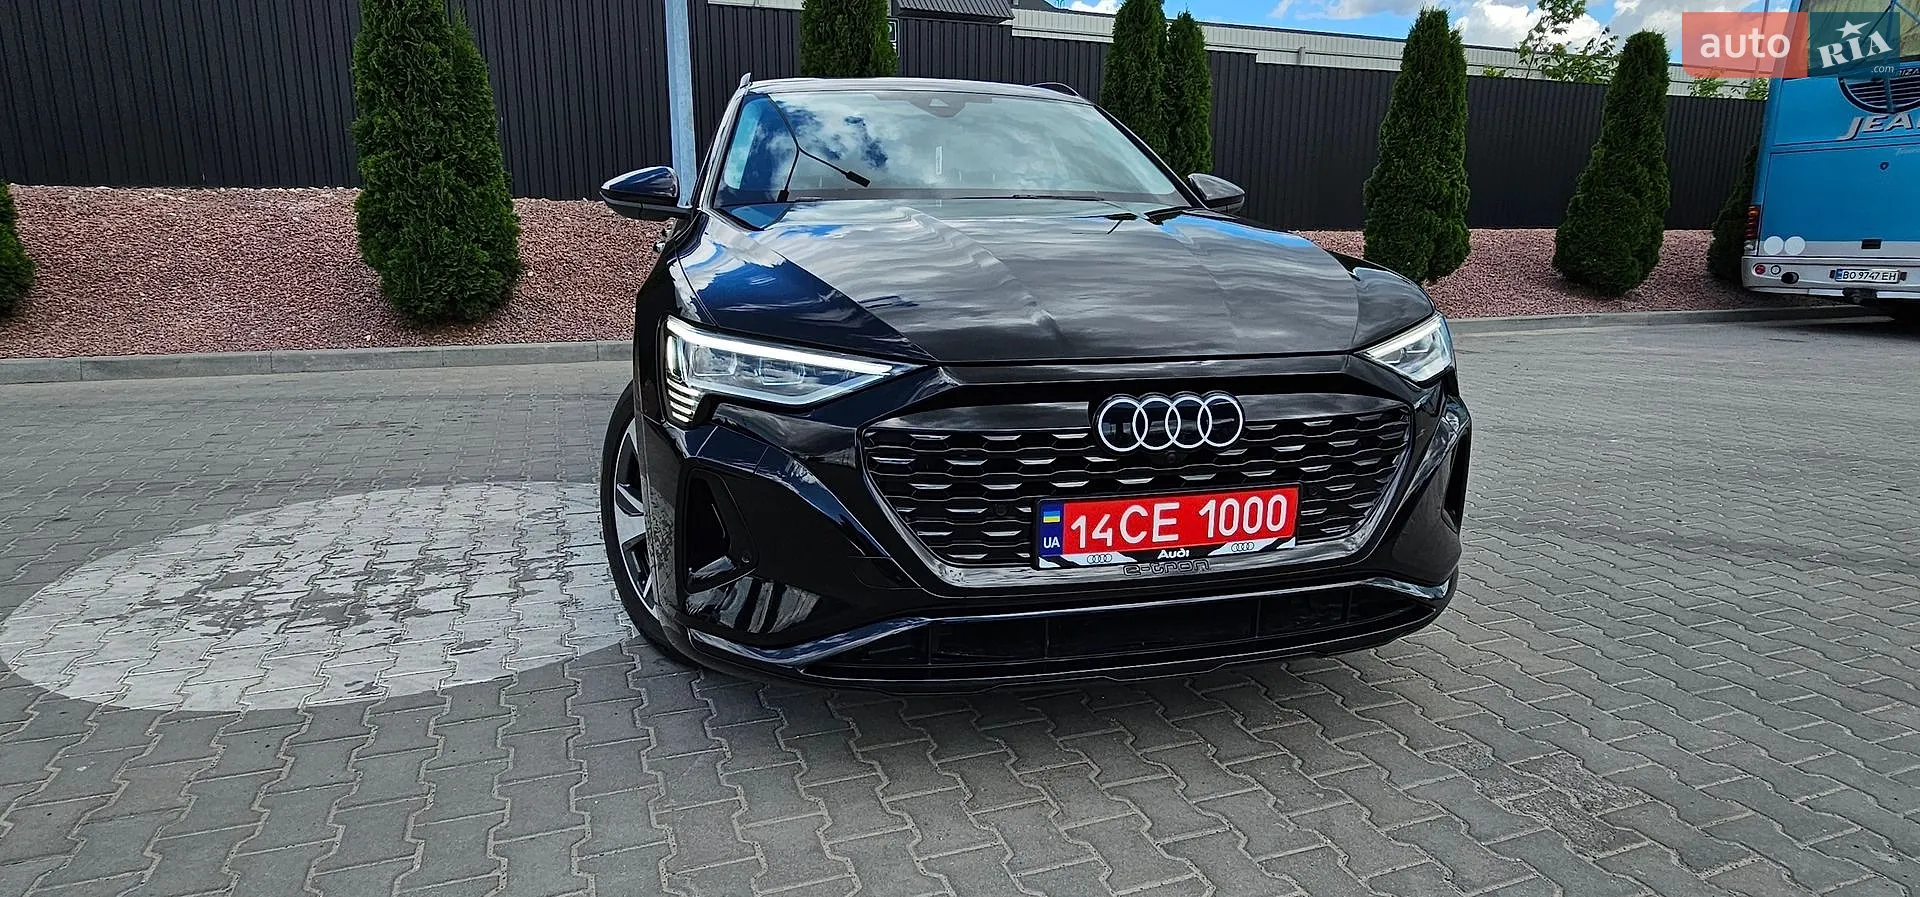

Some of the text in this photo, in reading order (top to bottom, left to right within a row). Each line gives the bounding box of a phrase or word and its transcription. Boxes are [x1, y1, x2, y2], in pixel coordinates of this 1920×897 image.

[1836, 112, 1920, 141] JEA
[1858, 271, 1880, 281] 9747
[1881, 272, 1897, 281] EH
[1198, 493, 1288, 539] 1000
[1043, 536, 1061, 549] UA
[1157, 548, 1190, 560] Audi
[1123, 558, 1210, 577] e-tron
